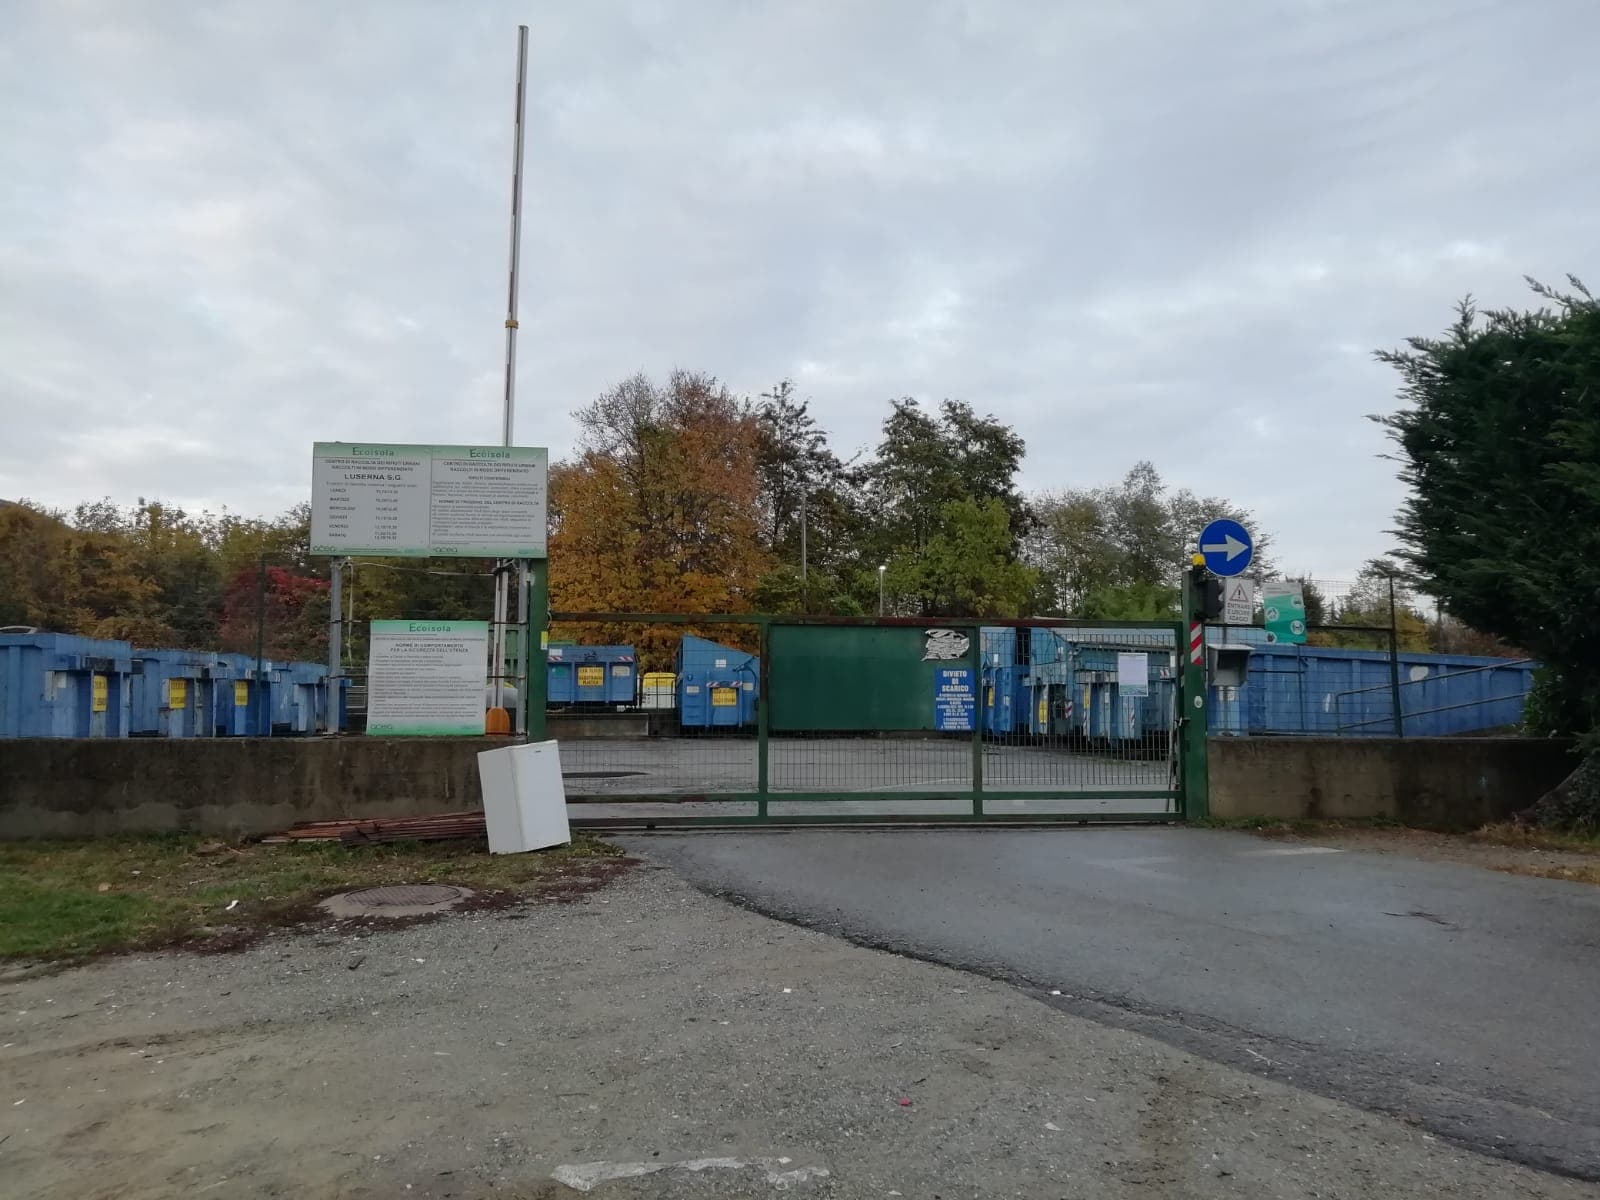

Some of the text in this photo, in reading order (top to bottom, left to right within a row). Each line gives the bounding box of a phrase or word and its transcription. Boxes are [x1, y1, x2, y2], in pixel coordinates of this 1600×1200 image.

[352, 447, 394, 456] Ecoisola
[470, 448, 510, 458] Ecoisola
[409, 622, 451, 632] Ecoisola
